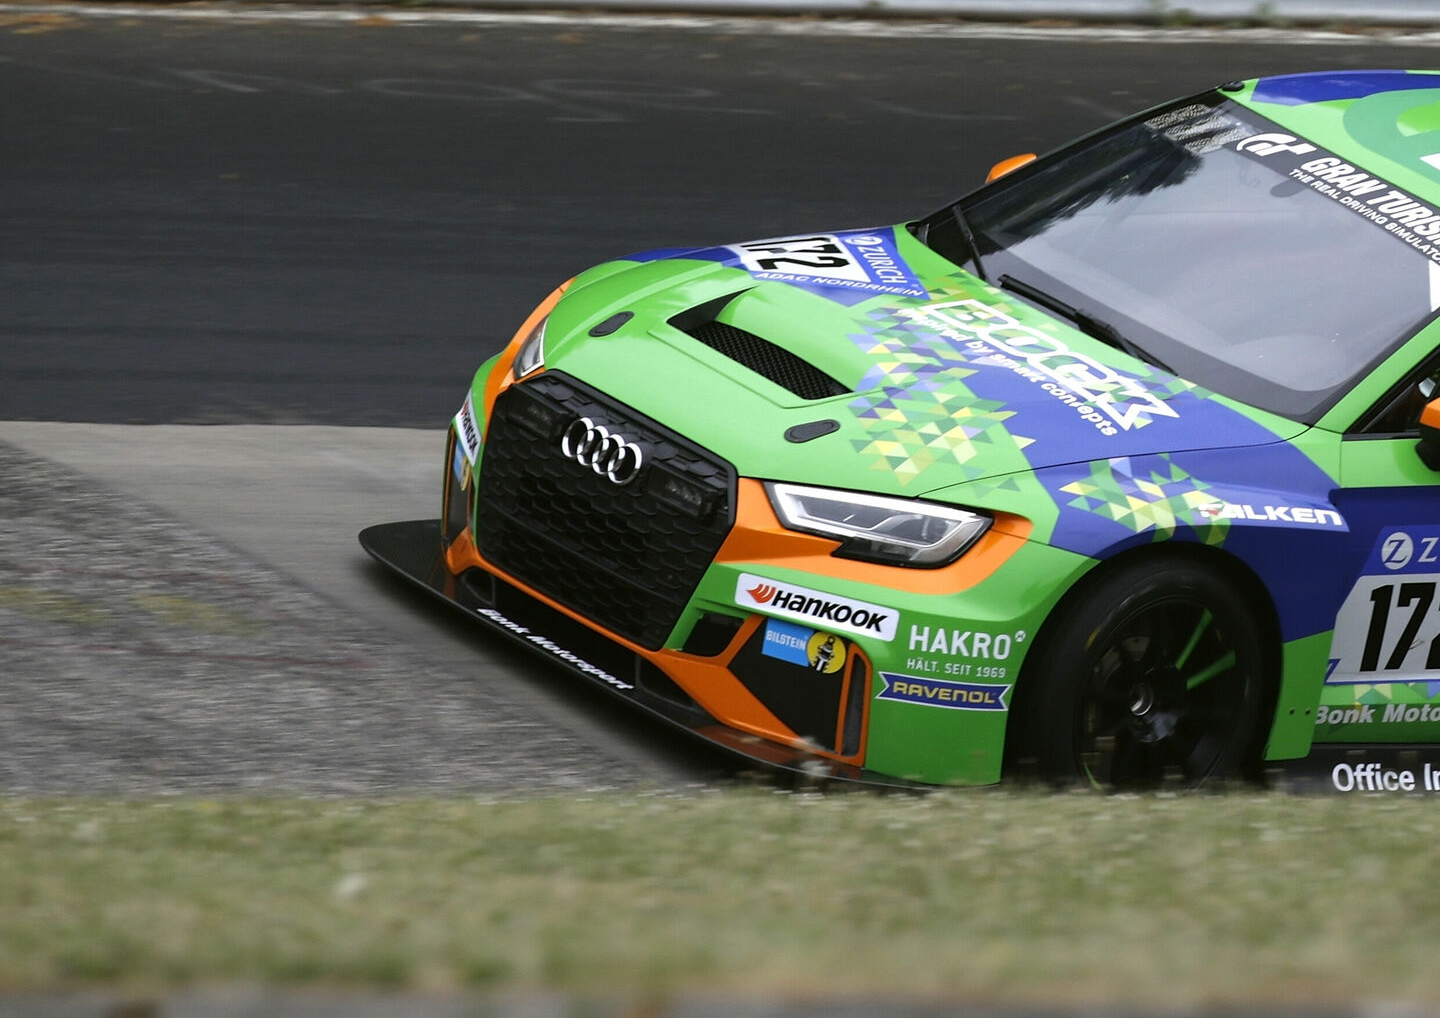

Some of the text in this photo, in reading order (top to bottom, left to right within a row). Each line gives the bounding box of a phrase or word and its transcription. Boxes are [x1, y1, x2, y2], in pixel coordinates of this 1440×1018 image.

[1301, 157, 1388, 197] GRAN
[1289, 168, 1315, 184] THE
[1310, 179, 1340, 199] REAL
[1339, 196, 1388, 225] DRIVING
[857, 246, 908, 284] ZURICH
[755, 273, 925, 297] ADAC NORDRHEIN
[918, 298, 1181, 432] BOCK
[766, 630, 807, 652] BILSTEIN
[909, 624, 1011, 660] HAKRO
[906, 657, 1007, 679] HÄLT. SEIT 1969
[893, 680, 996, 704] RAVENOL
[1315, 704, 1376, 725] Bonk
[1331, 763, 1416, 792] Office
